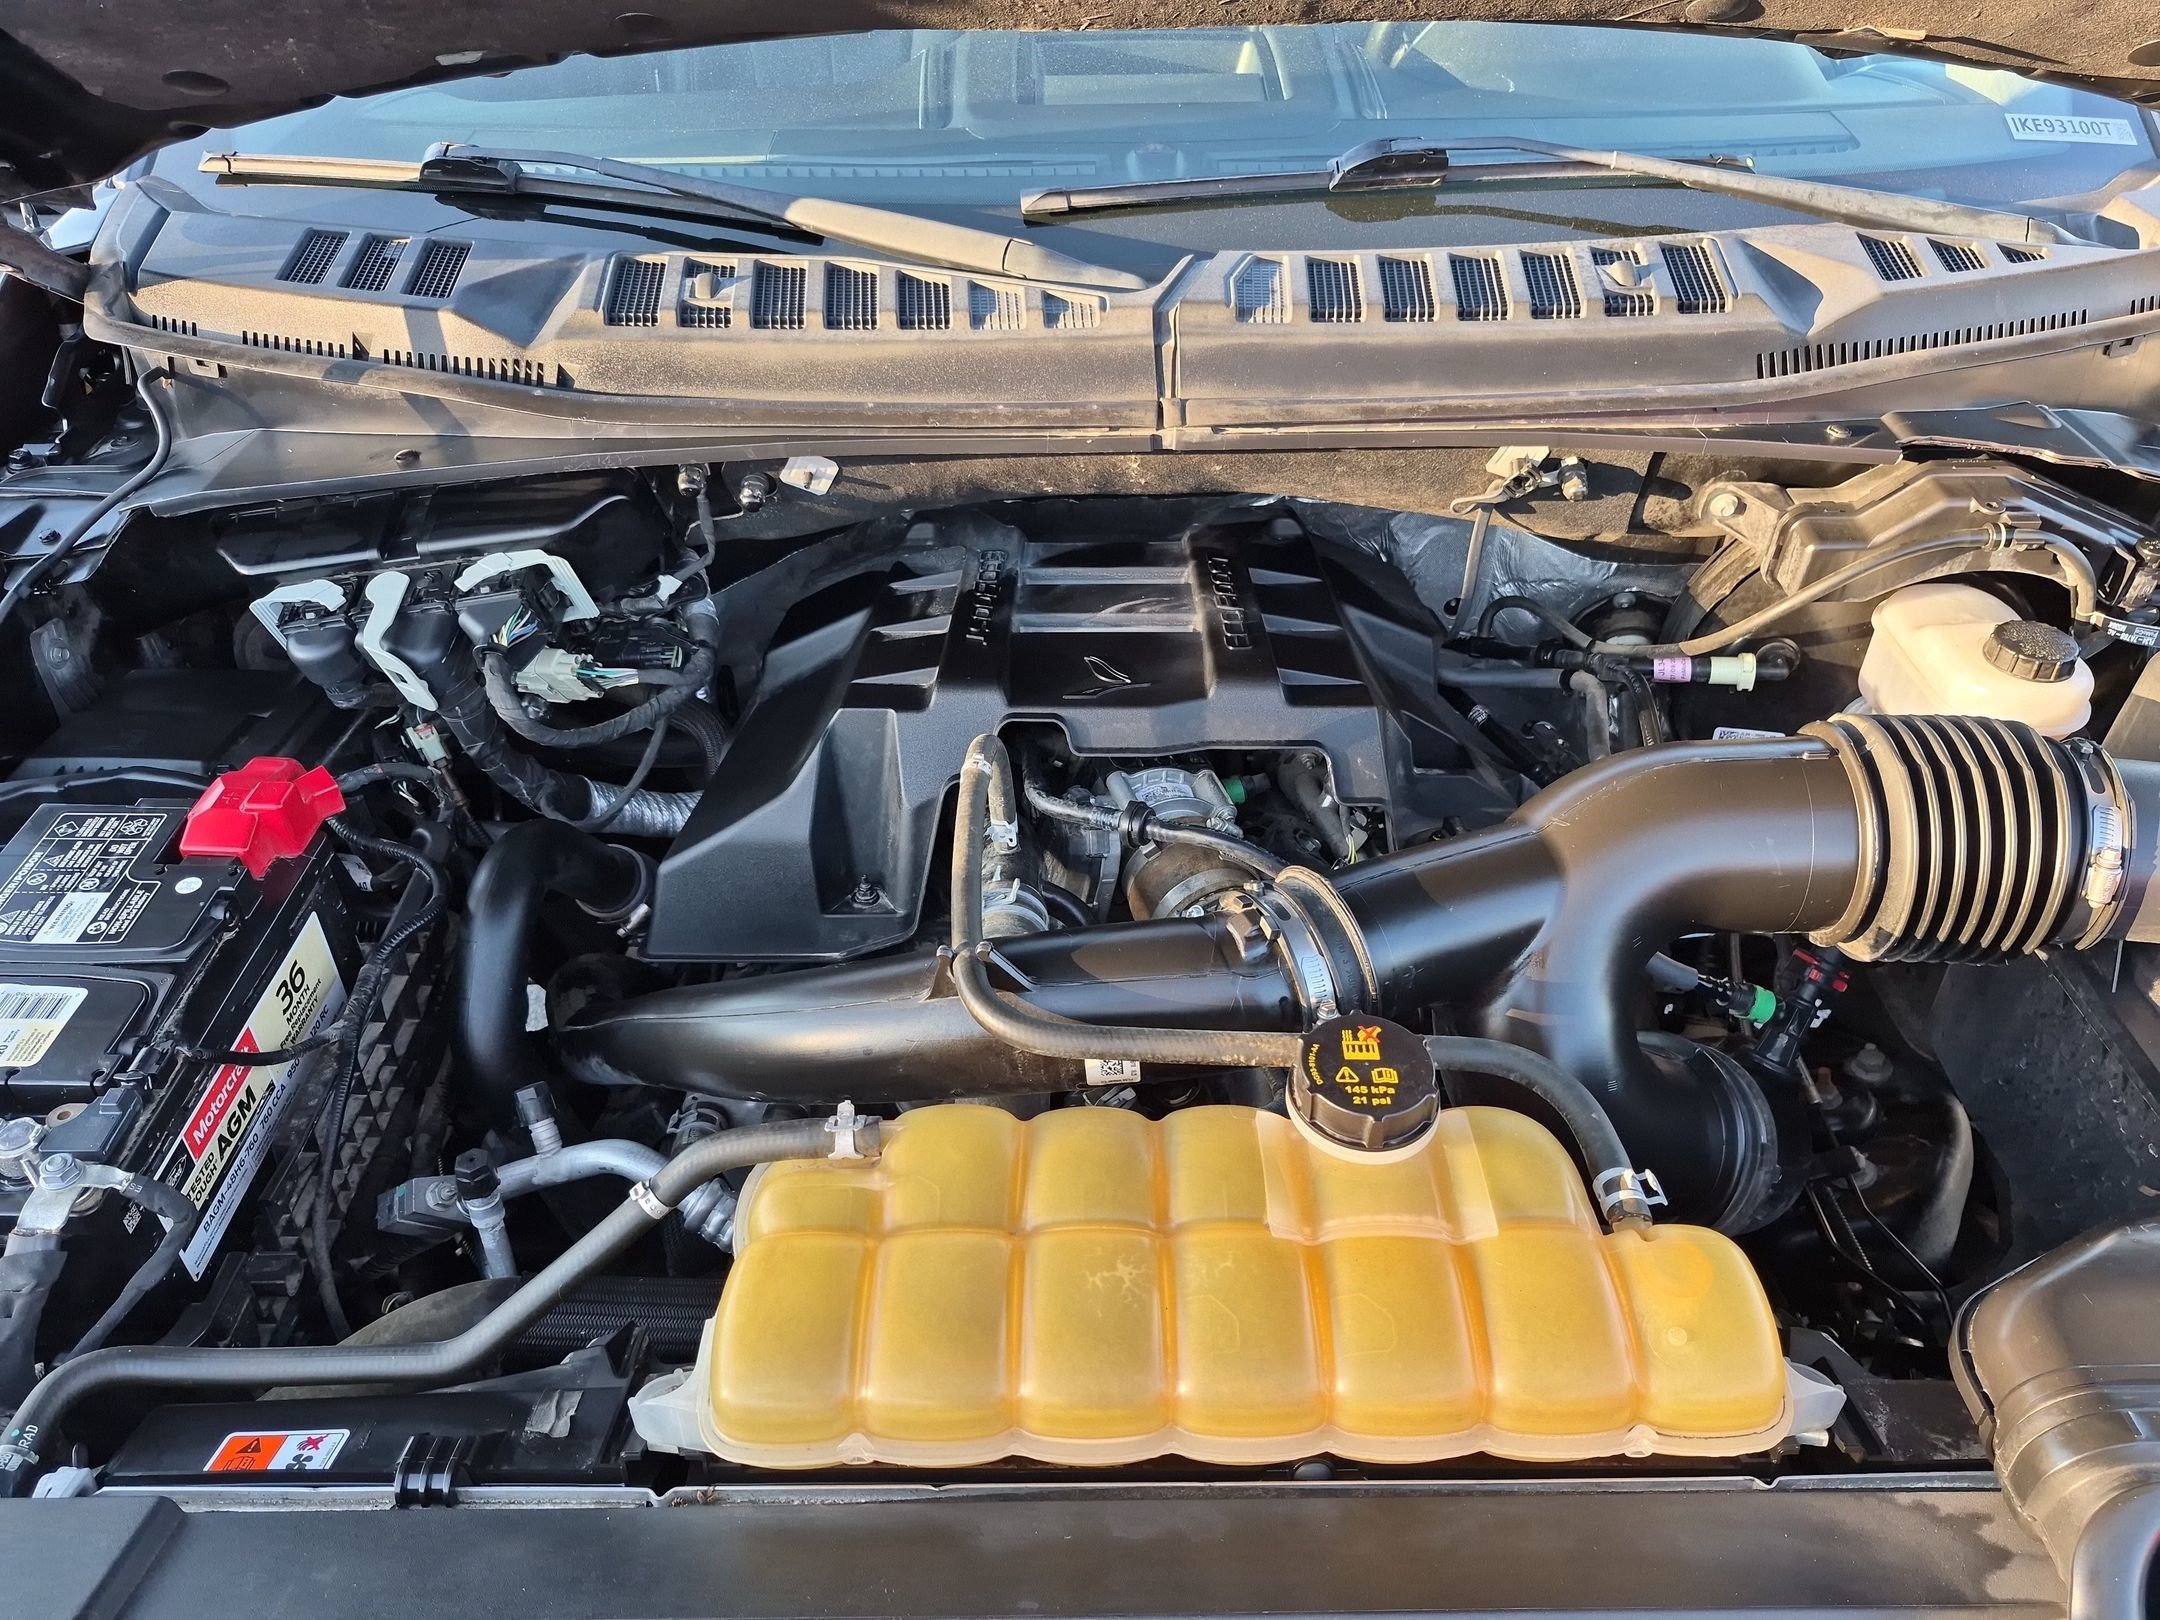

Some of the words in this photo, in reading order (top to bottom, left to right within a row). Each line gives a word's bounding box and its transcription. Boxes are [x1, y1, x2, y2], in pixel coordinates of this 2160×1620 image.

[276, 960, 305, 1016] 36
[286, 984, 310, 1025] MONTH
[290, 978, 322, 1030] Replacement
[290, 996, 319, 1044] WARRANTY
[1345, 1085, 1369, 1095] 145
[1371, 1085, 1396, 1095] kPa
[1353, 1097, 1368, 1105] 21
[1371, 1097, 1392, 1106] psi
[203, 1132, 260, 1233] BAGM-48H6-760
[260, 1107, 273, 1129] 760
[272, 1084, 287, 1108] CCA
[320, 1004, 330, 1021] RC
[216, 1084, 257, 1163] AGM
[19, 1424, 39, 1448] RAD
